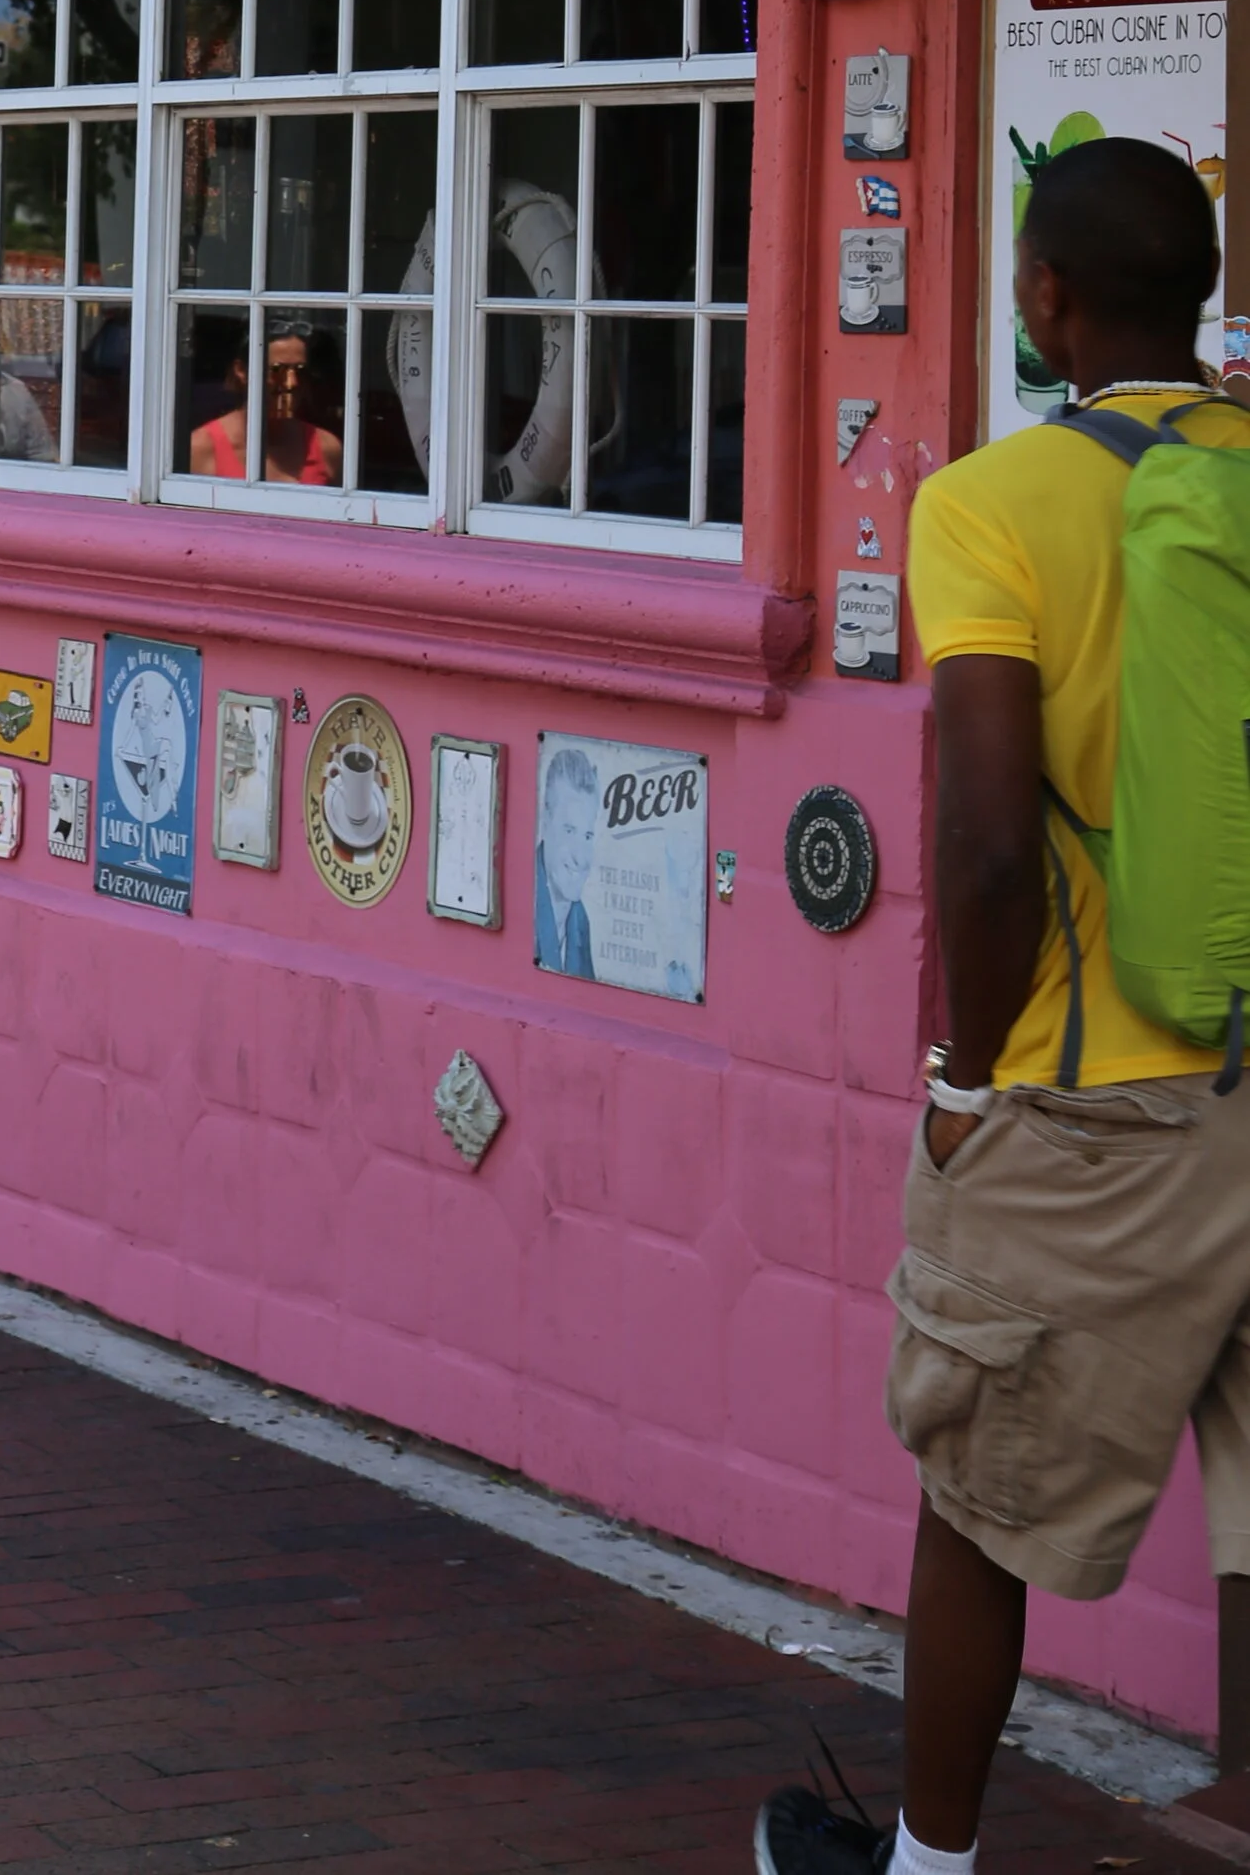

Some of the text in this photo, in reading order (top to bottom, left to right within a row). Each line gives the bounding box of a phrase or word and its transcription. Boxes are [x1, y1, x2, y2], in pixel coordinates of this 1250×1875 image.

[1007, 20, 1044, 47] BEST
[1050, 17, 1104, 45] CUBAN
[1111, 15, 1167, 42] CUSINE
[1176, 13, 1188, 40] IN
[1048, 53, 1202, 78] THE BEST CUBAN MOJITO
[848, 73, 873, 86] LATTE
[848, 250, 893, 263] ESPRESSO
[840, 599, 891, 617] CAPPUCCINO
[330, 711, 388, 749] HAVE
[603, 768, 700, 828] BEER
[101, 816, 189, 861] LADIES NIGHT
[310, 792, 400, 891] ANOTHER CUP
[98, 868, 188, 910] EVERYNIGHT
[599, 865, 661, 893] THE REASON
[609, 892, 638, 915] WAKE
[611, 918, 645, 941] EVERY
[598, 943, 658, 970] AFTERNOON
